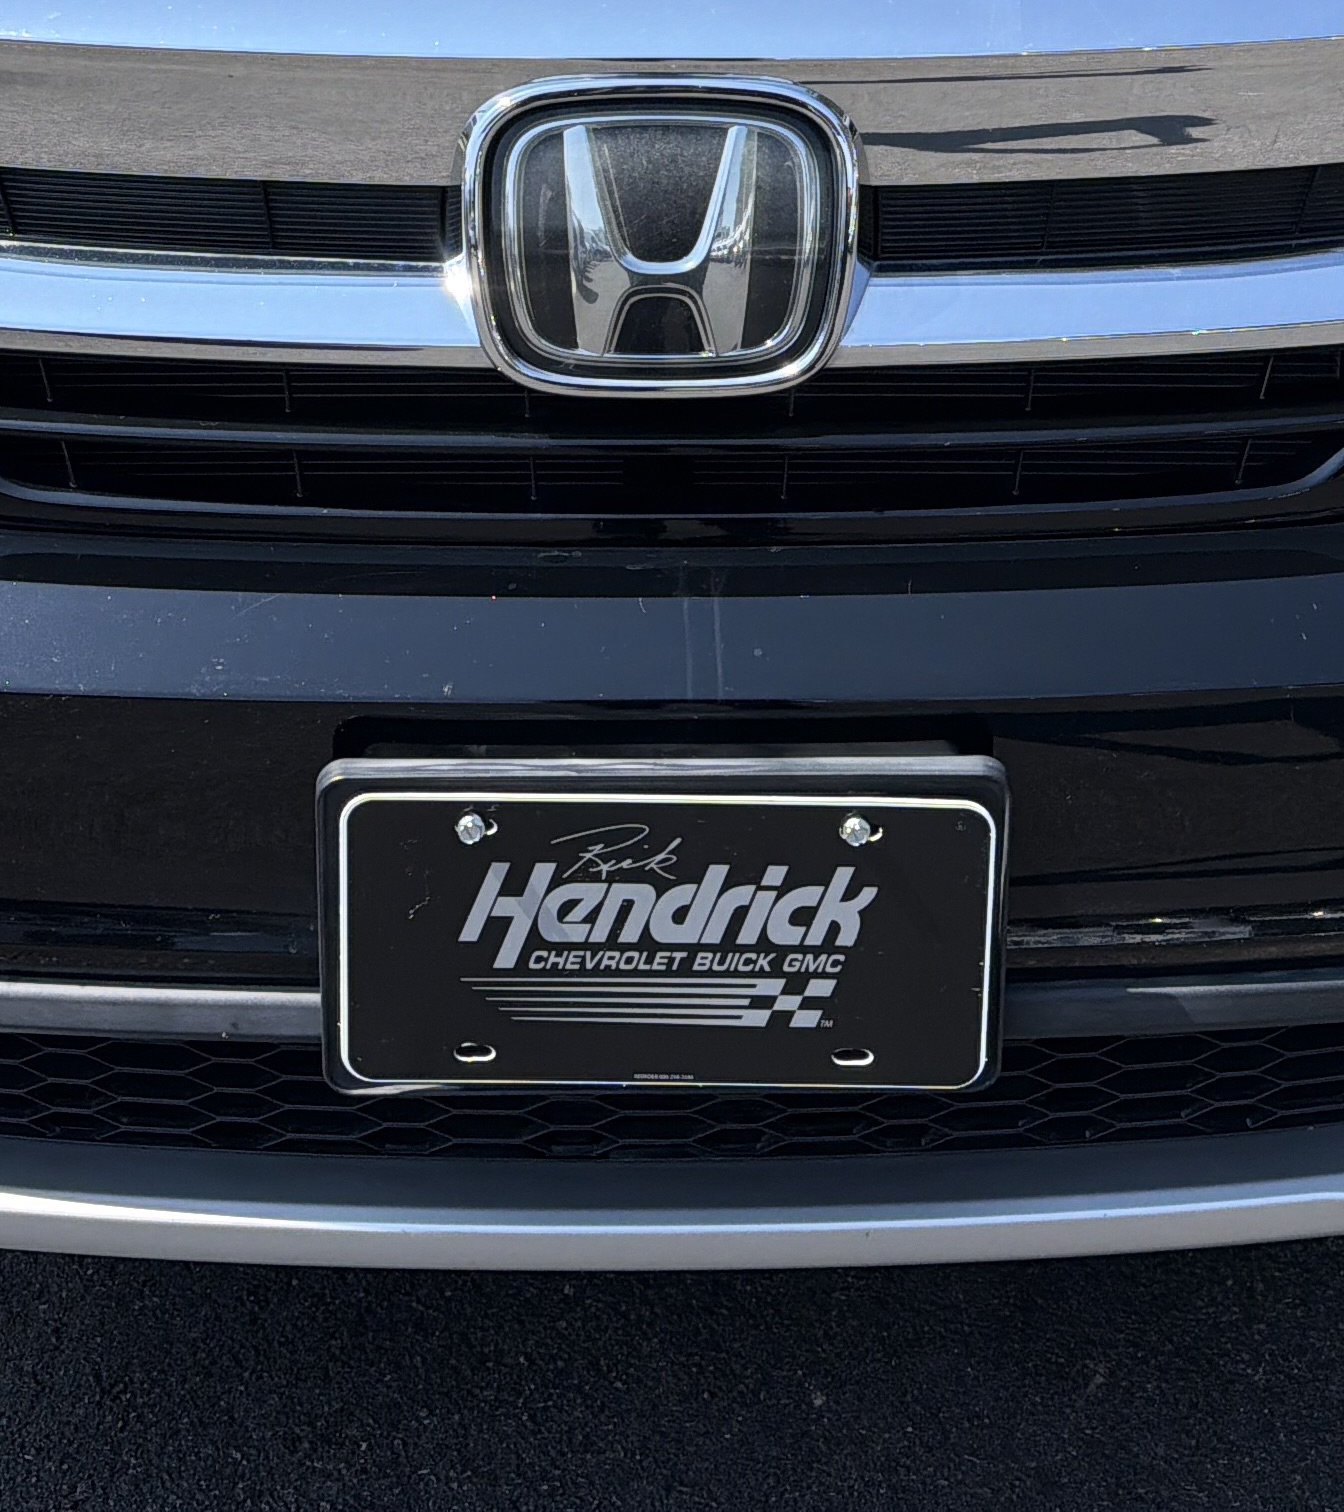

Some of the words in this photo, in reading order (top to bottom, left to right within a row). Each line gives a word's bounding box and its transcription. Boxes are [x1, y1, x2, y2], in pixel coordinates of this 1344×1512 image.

[550, 823, 683, 880] Rick
[457, 861, 880, 969] Hendrick
[528, 950, 687, 971] CHEVROLET
[692, 951, 777, 973] BUICK
[782, 953, 846, 974] GMC
